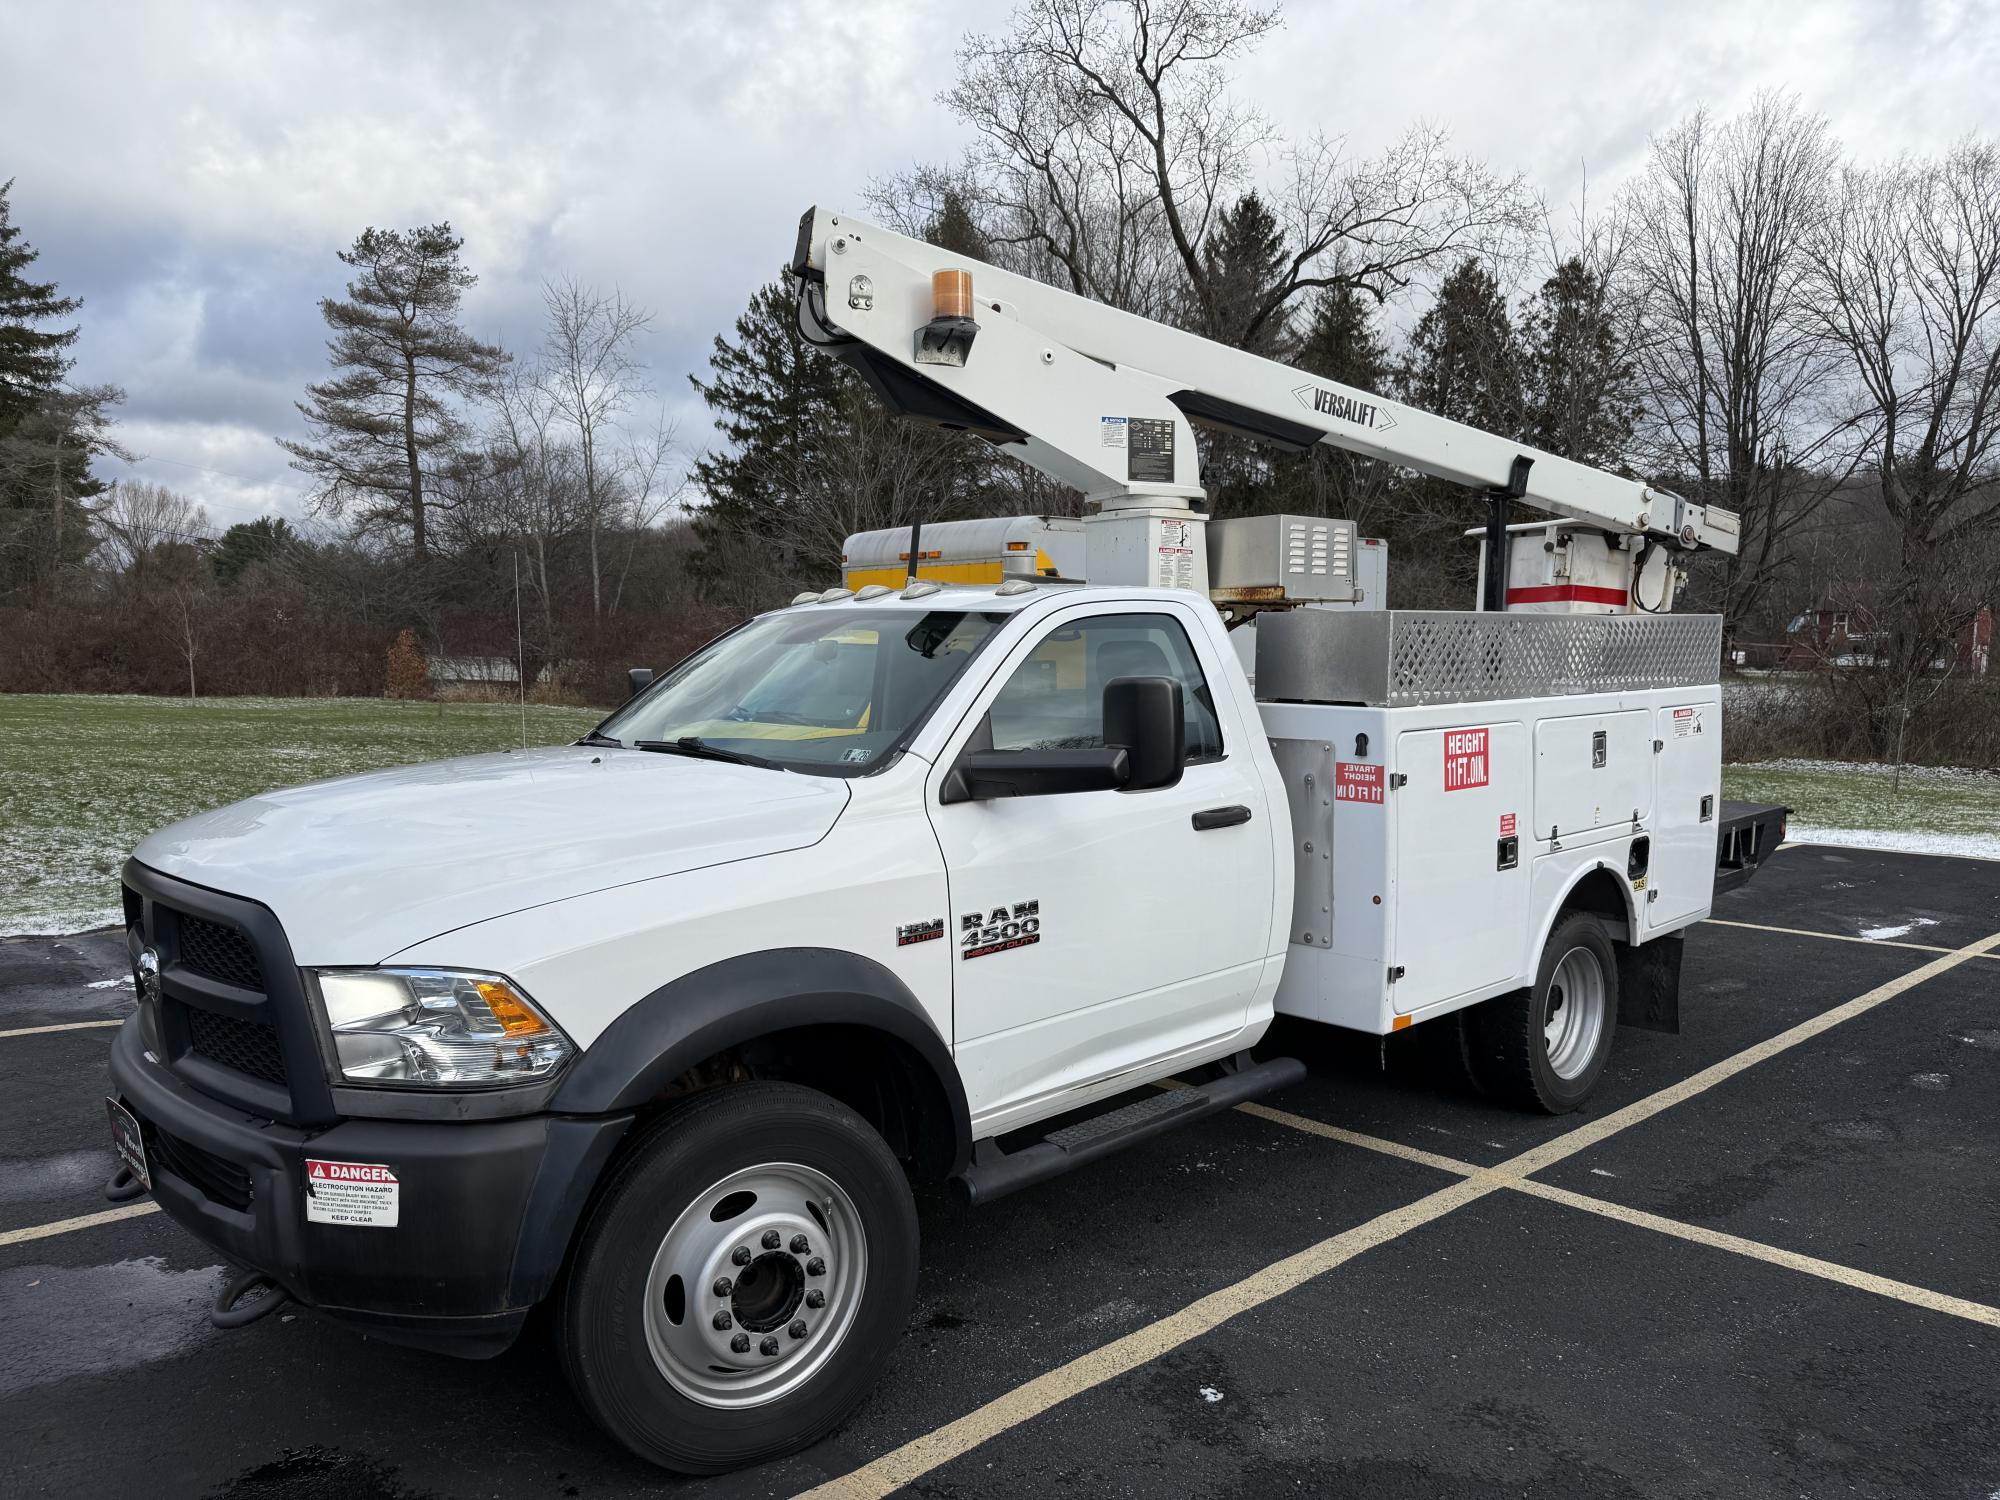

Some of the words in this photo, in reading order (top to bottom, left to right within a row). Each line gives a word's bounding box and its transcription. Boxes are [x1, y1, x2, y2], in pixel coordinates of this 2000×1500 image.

[1314, 387, 1377, 428] VERSALIFT
[1448, 732, 1485, 755] HEIGHT
[1633, 879, 1645, 889] GAS
[961, 899, 1039, 932] RAM
[916, 931, 943, 942] LITER
[960, 916, 1040, 946] 4500
[966, 943, 1005, 958] HEAVY
[1007, 936, 1037, 949] DUTY
[330, 1165, 391, 1181] DANGER
[312, 1181, 364, 1192] ELECTROCUTION
[365, 1185, 393, 1193] HAZARD
[350, 1215, 373, 1223] CLEAR
